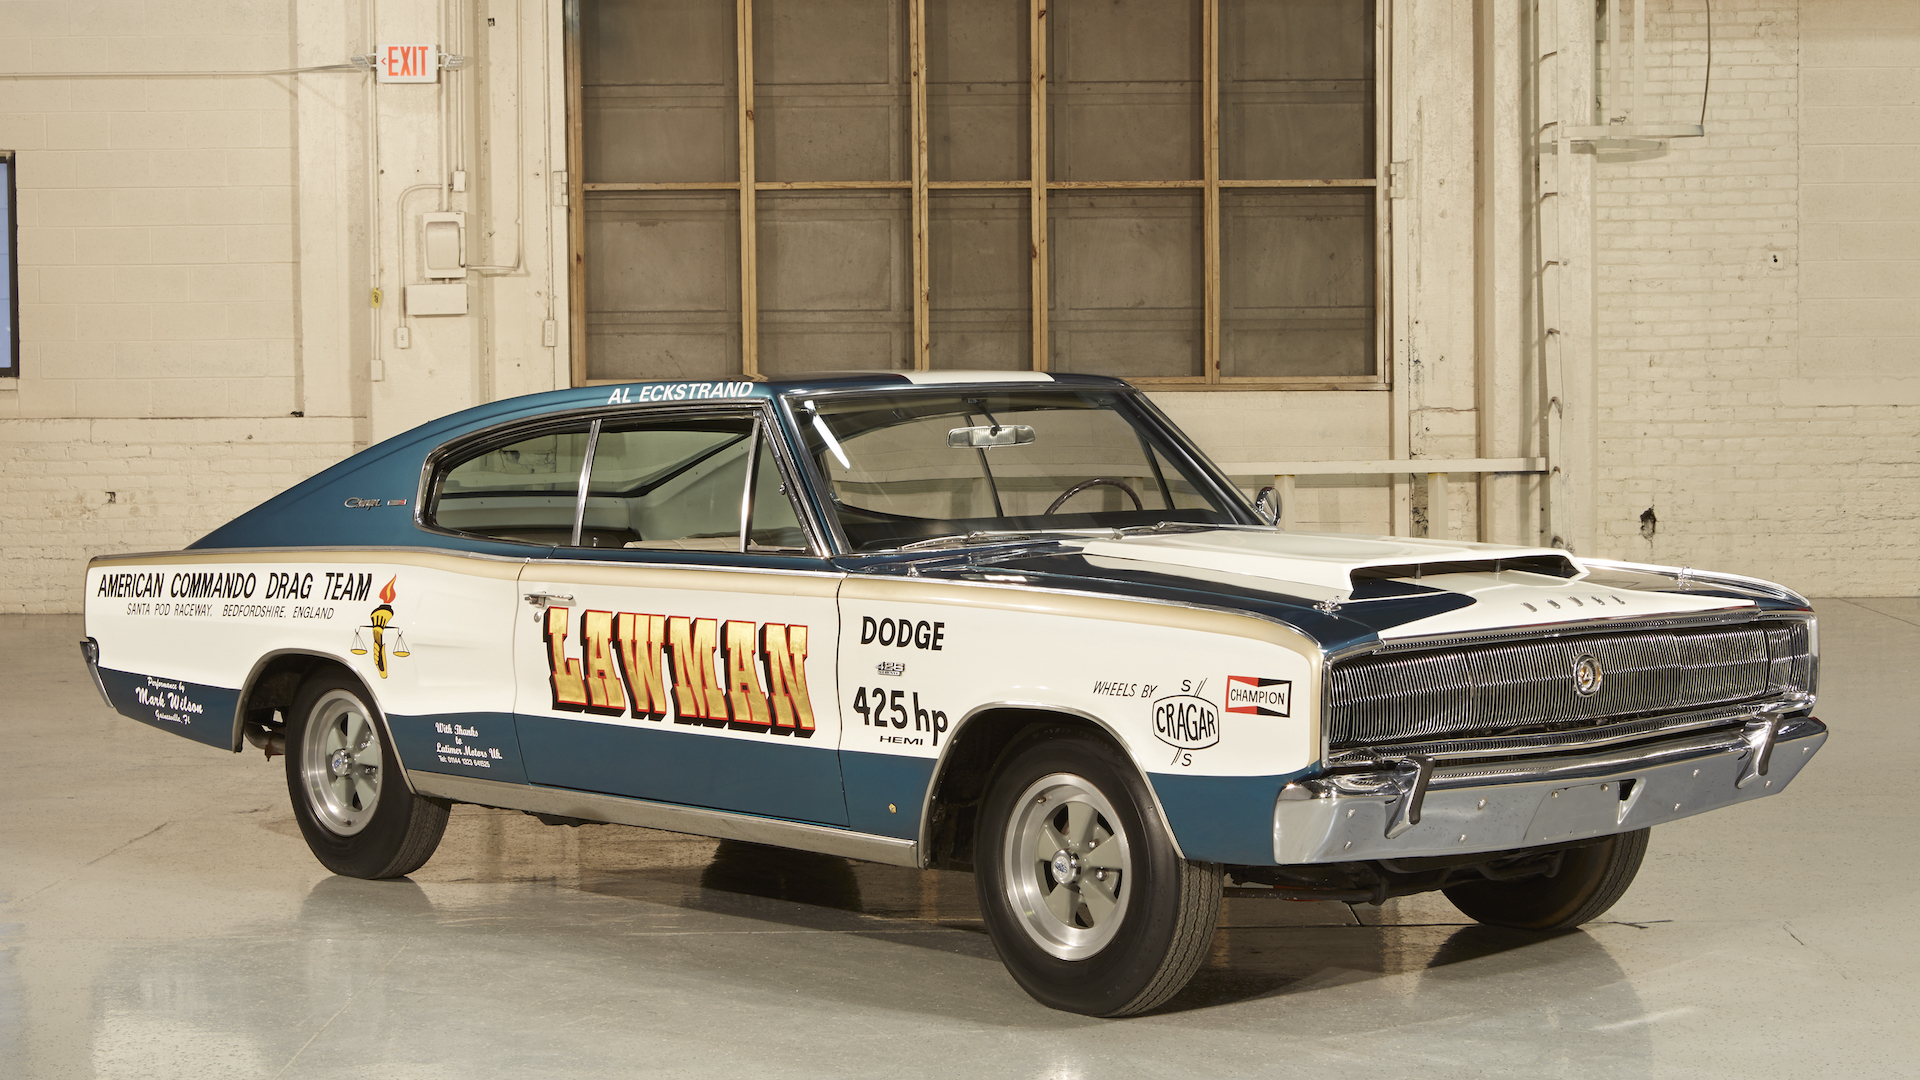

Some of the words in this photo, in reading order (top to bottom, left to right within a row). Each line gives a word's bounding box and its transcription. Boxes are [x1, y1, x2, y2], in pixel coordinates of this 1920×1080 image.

[388, 46, 429, 76] EXIT
[607, 388, 632, 404] AL
[639, 382, 754, 402] ECKSTRAND
[97, 573, 164, 598] AMERICAN
[170, 572, 256, 599] COMMANDO
[265, 572, 314, 599] DRAG
[324, 572, 373, 601] TEAM
[126, 603, 151, 616] SANTA
[154, 603, 171, 616] POD
[292, 606, 335, 620] ENGLAND
[860, 616, 945, 651] DODGE
[543, 606, 816, 739] LAWMAN
[146, 676, 177, 690] Performance
[178, 681, 186, 693] by
[1092, 681, 1137, 697] WHEELS
[1141, 684, 1158, 698] BY
[1181, 679, 1192, 692] S
[134, 686, 166, 708] Mark
[167, 692, 204, 714] Wilson
[1230, 688, 1285, 705] CHAMPION
[853, 686, 908, 729] 425
[913, 692, 948, 746] hp
[1156, 703, 1216, 741] CRAGAR
[435, 722, 453, 735] With
[454, 724, 478, 737] Thanks
[455, 735, 463, 745] to
[879, 735, 924, 746] HEMI
[436, 742, 462, 755] Latimer
[463, 745, 488, 758] Motors
[1181, 753, 1192, 766] S
